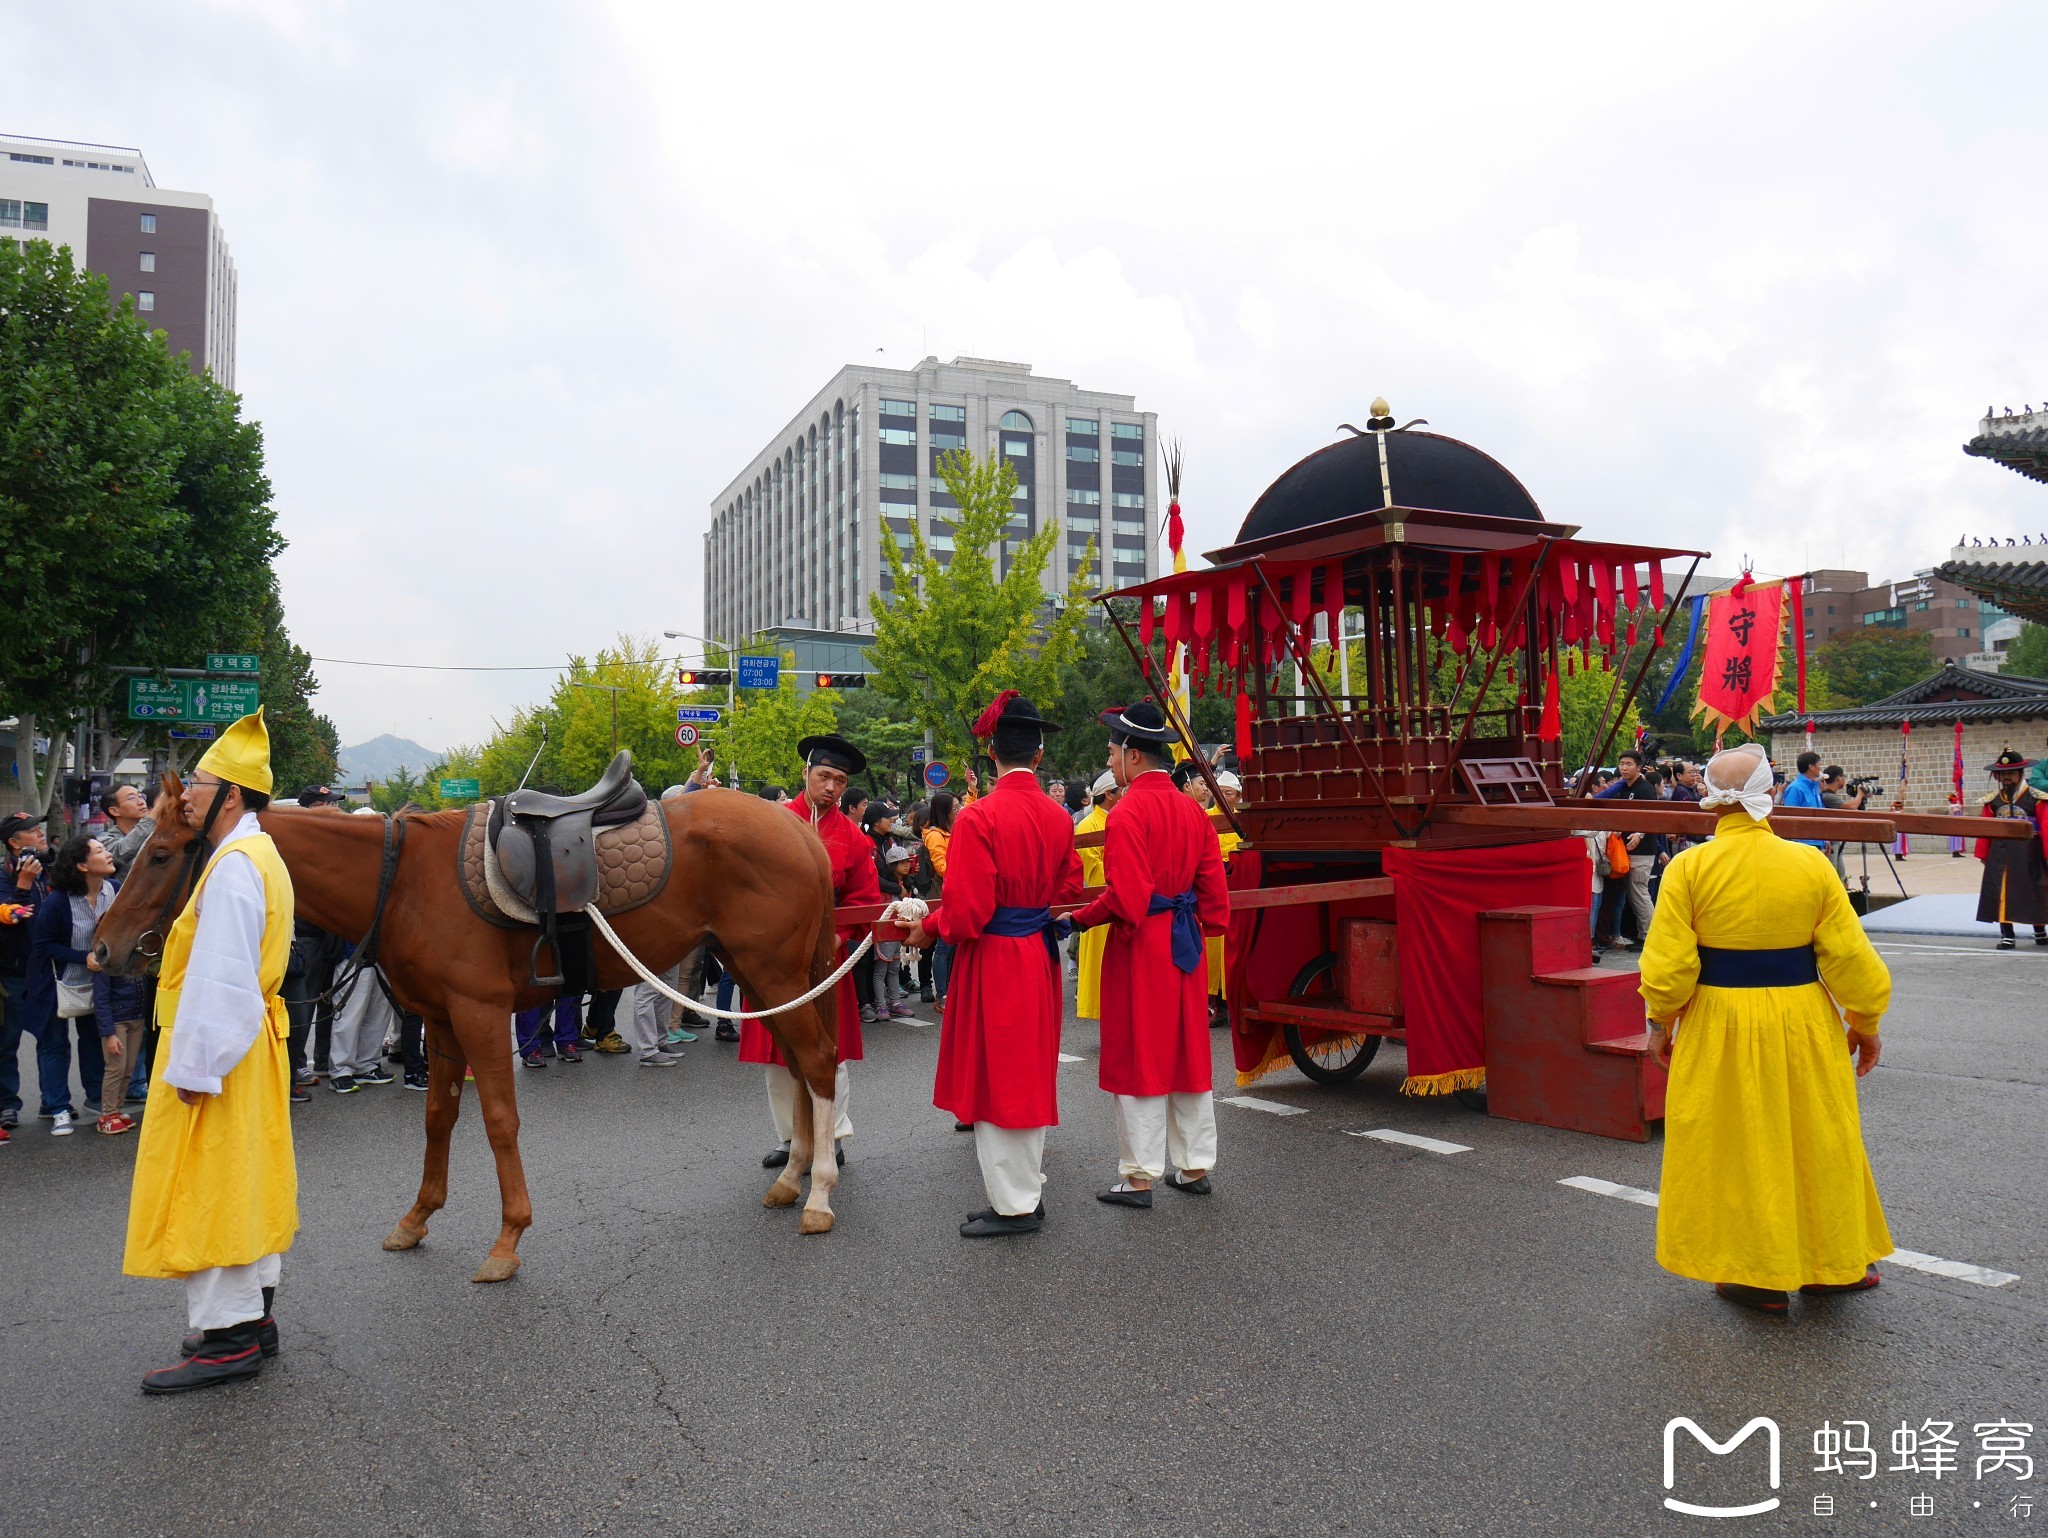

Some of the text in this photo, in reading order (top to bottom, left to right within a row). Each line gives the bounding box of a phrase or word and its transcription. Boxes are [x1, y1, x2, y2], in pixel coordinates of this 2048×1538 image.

[1721, 607, 1756, 694] 守將
[213, 657, 252, 668] 창덕궁
[742, 659, 776, 668] 좌회전금지
[743, 669, 763, 677] 07:00
[211, 684, 238, 694] 광화문
[141, 705, 148, 714] 6
[211, 702, 244, 713] 안국역
[681, 729, 693, 741] 60
